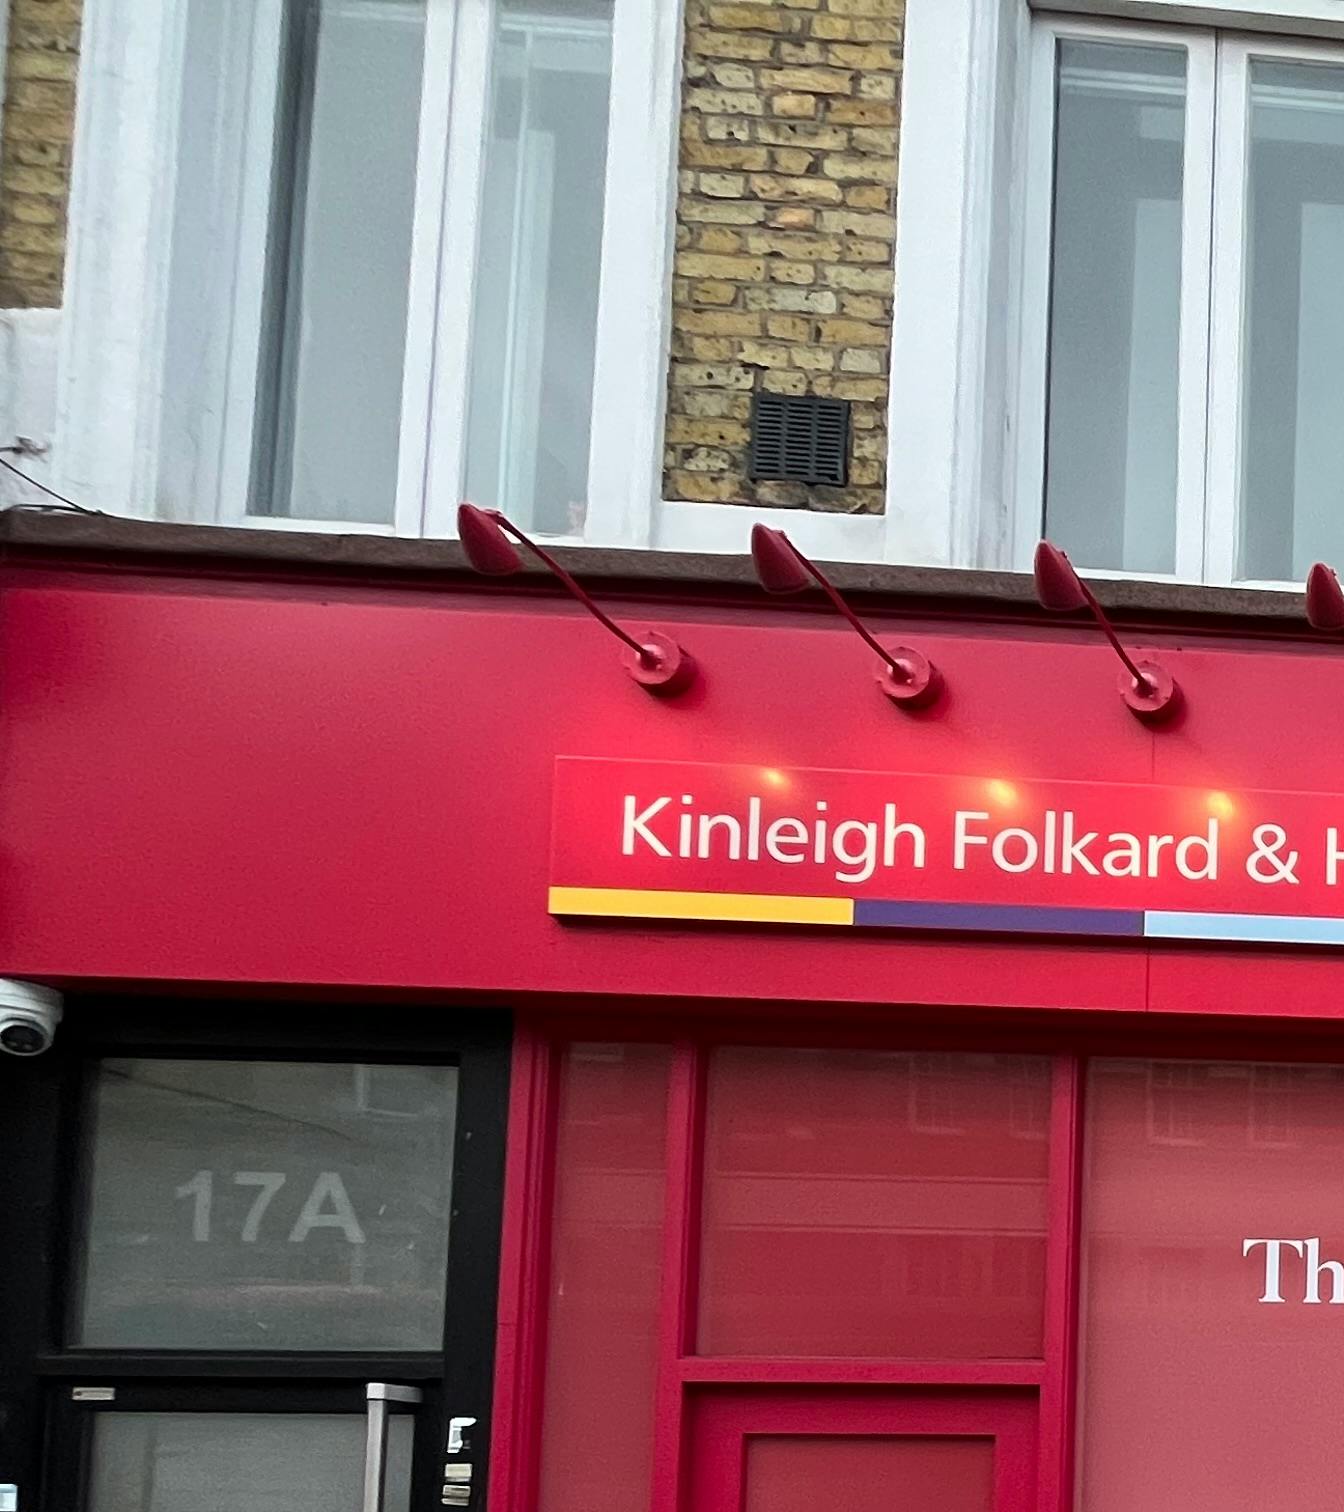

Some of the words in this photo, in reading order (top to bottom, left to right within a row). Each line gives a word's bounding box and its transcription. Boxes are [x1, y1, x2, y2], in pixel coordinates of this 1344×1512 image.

[620, 796, 925, 883] Kinleigh
[953, 809, 1220, 882] Folkard
[1245, 825, 1298, 884] &
[174, 1170, 367, 1246] 17A
